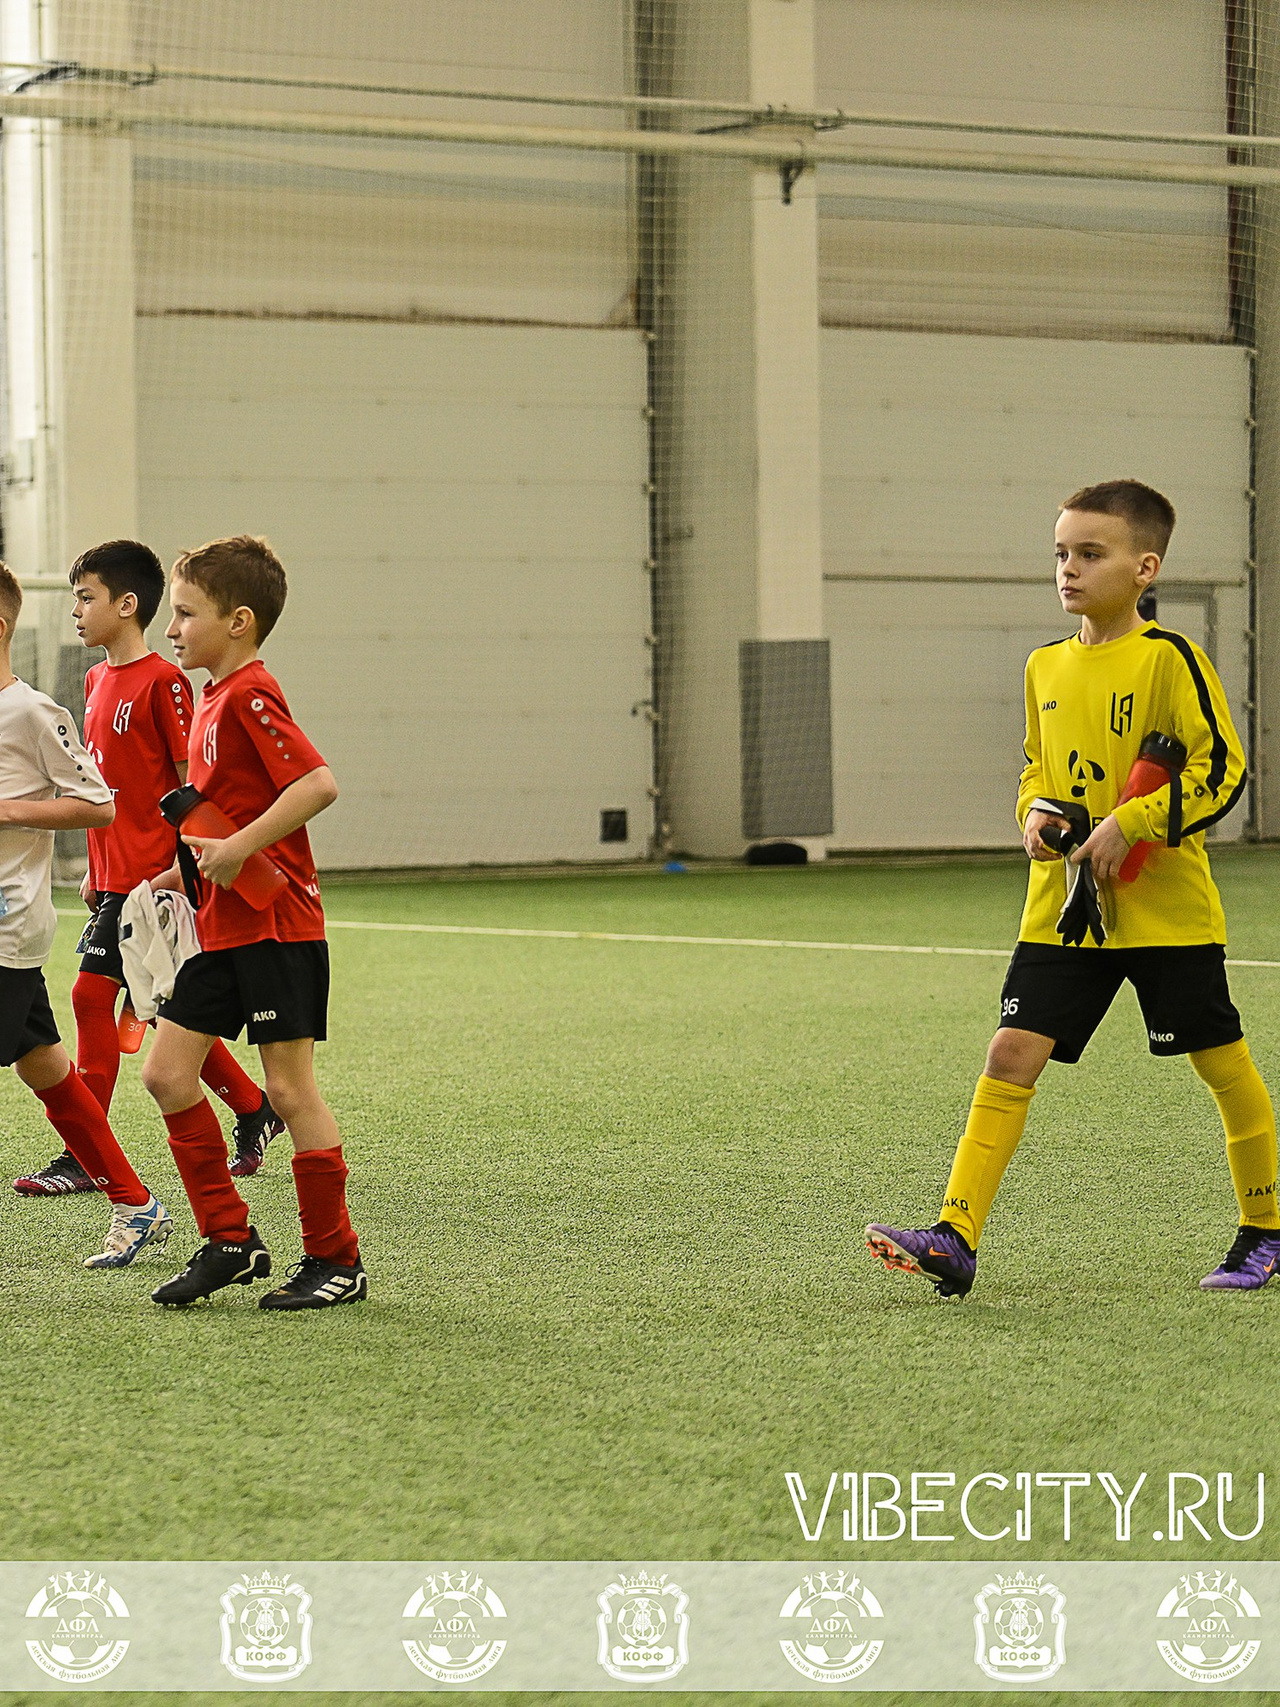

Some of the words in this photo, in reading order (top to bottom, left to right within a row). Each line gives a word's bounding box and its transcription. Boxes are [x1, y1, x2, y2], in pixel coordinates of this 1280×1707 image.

[1041, 700, 1057, 712] AKO
[252, 1010, 277, 1022] AKO
[943, 1197, 969, 1211] AKO
